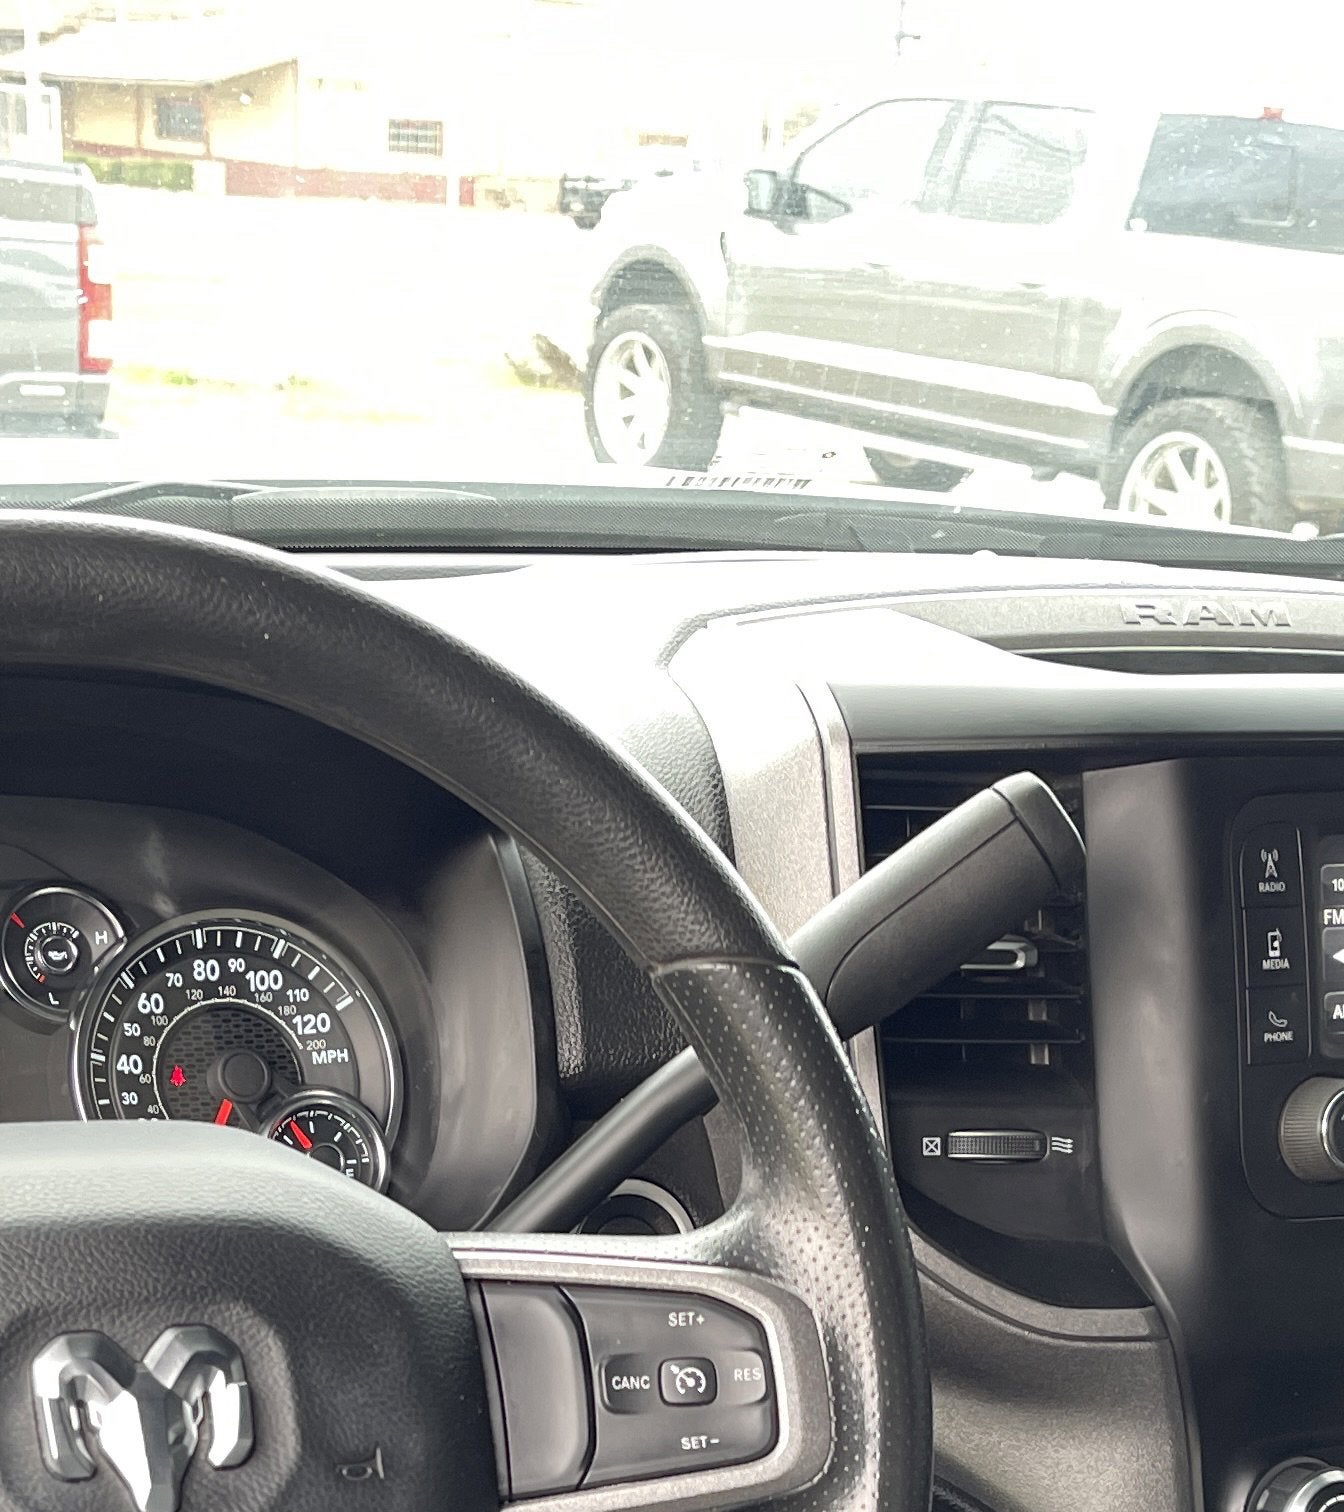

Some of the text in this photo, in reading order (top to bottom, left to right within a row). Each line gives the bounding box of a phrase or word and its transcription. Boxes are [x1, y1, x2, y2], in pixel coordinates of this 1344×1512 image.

[1120, 601, 1293, 627] RAM
[1258, 881, 1286, 893] RADIO
[1323, 909, 1344, 925] FM
[95, 931, 107, 945] H
[193, 959, 219, 981] 80
[227, 958, 245, 973] 90
[1262, 958, 1290, 971] MEDIA
[165, 973, 183, 988] 70
[245, 970, 283, 992] 100
[186, 989, 203, 1001] 120
[218, 985, 237, 996] 140
[286, 988, 309, 1003] 110
[137, 993, 164, 1015] 60
[278, 1005, 297, 1016] 180
[150, 1015, 168, 1026] 100
[292, 1012, 331, 1035] 120
[123, 1023, 141, 1037] 50
[1264, 1030, 1294, 1042] PHONE
[306, 1039, 326, 1051] 200
[312, 1049, 349, 1065] MPH
[116, 1054, 143, 1075] 40
[139, 1073, 152, 1084] 60
[121, 1092, 138, 1105] 30
[147, 1104, 160, 1115] 40
[733, 1367, 763, 1382] RES
[611, 1374, 651, 1391] CANC
